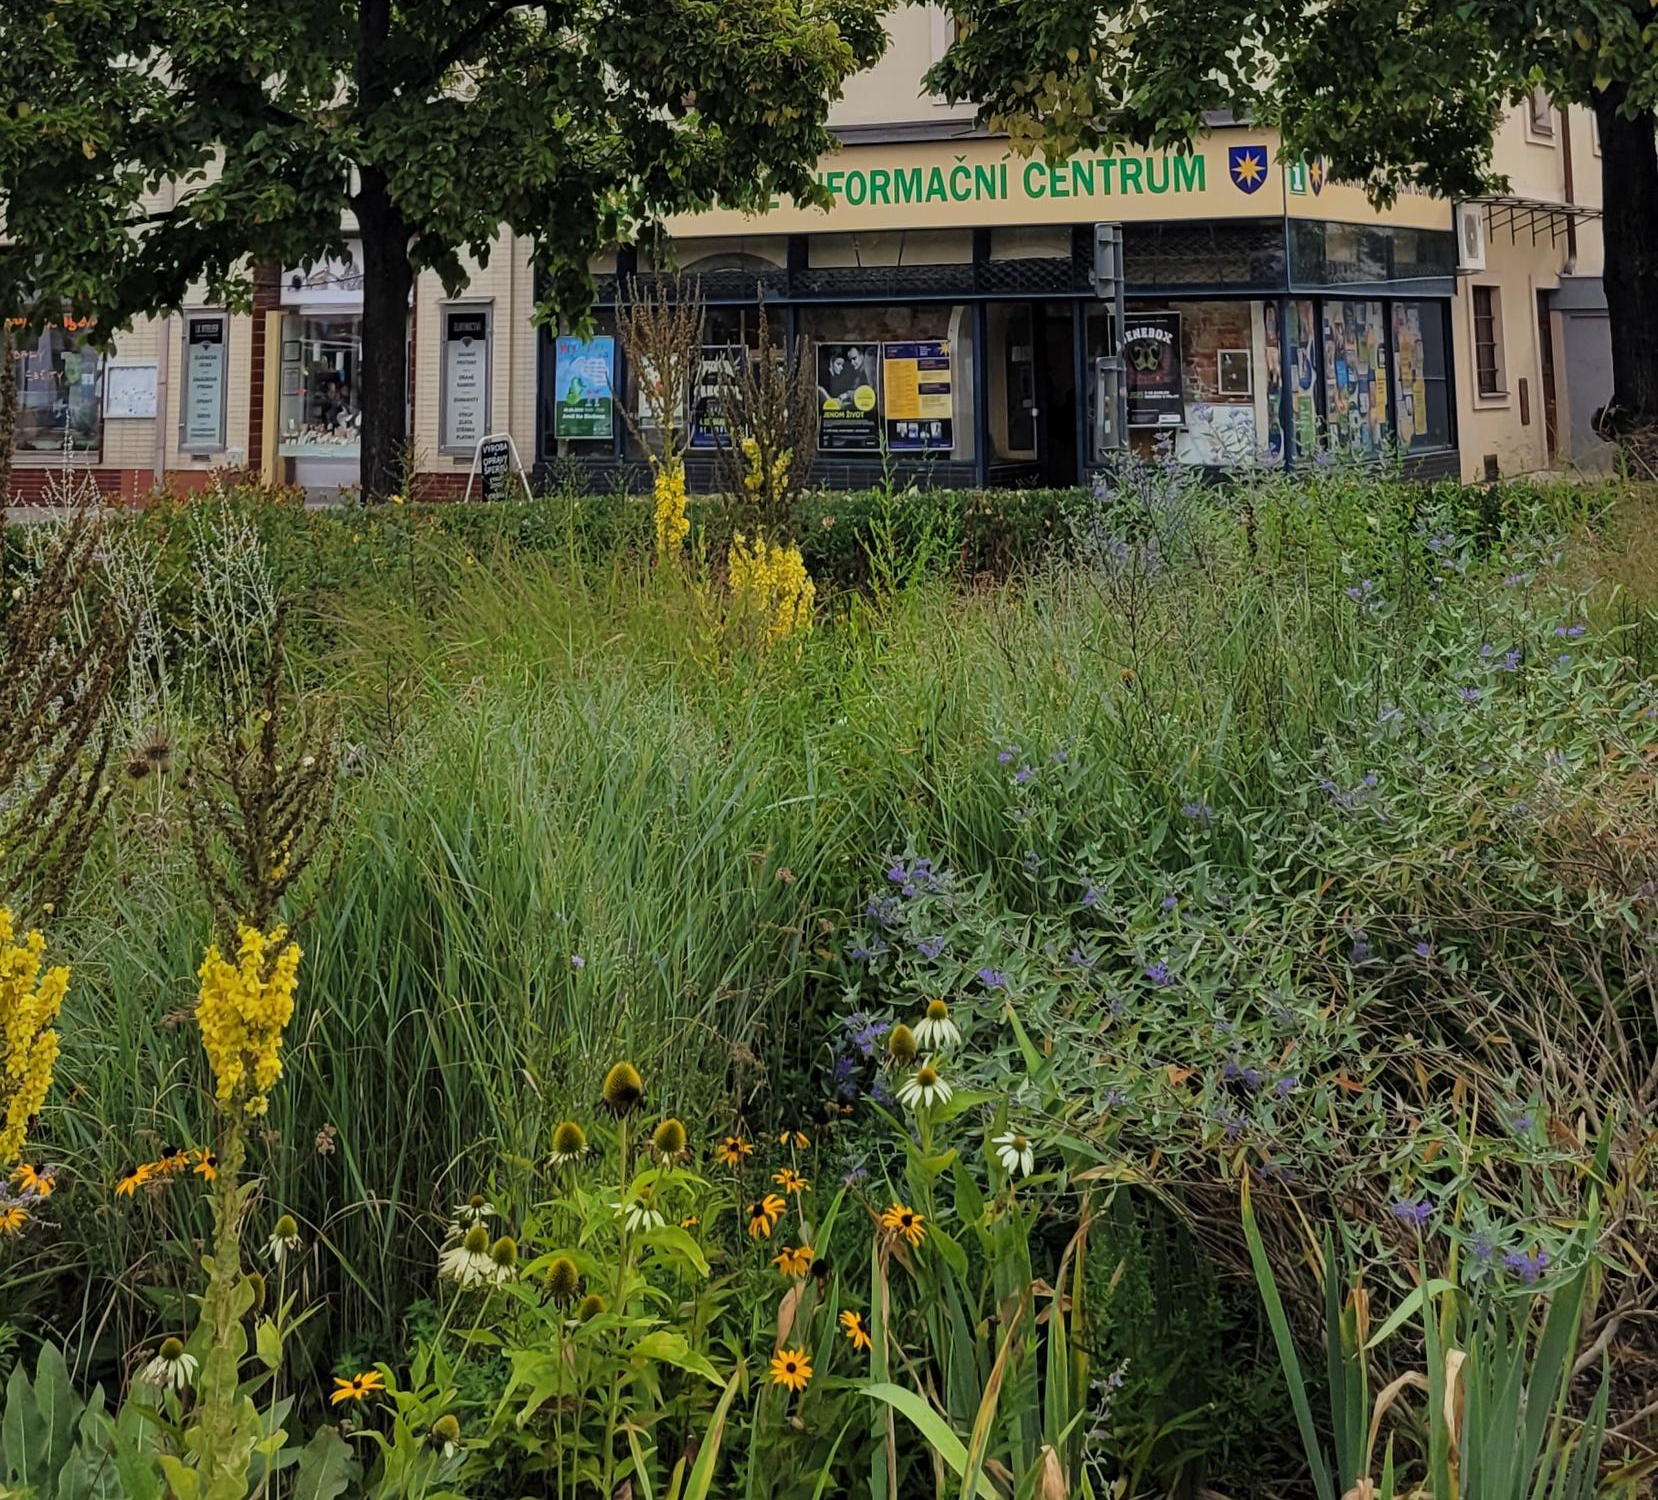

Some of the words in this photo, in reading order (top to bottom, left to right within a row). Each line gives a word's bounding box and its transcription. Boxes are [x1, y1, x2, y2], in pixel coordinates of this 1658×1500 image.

[803, 153, 1010, 205] FORMAČNÍ
[1022, 153, 1207, 199] CENTRUM
[1123, 326, 1173, 345] ENEBOX
[846, 409, 865, 419] ŽIVOT
